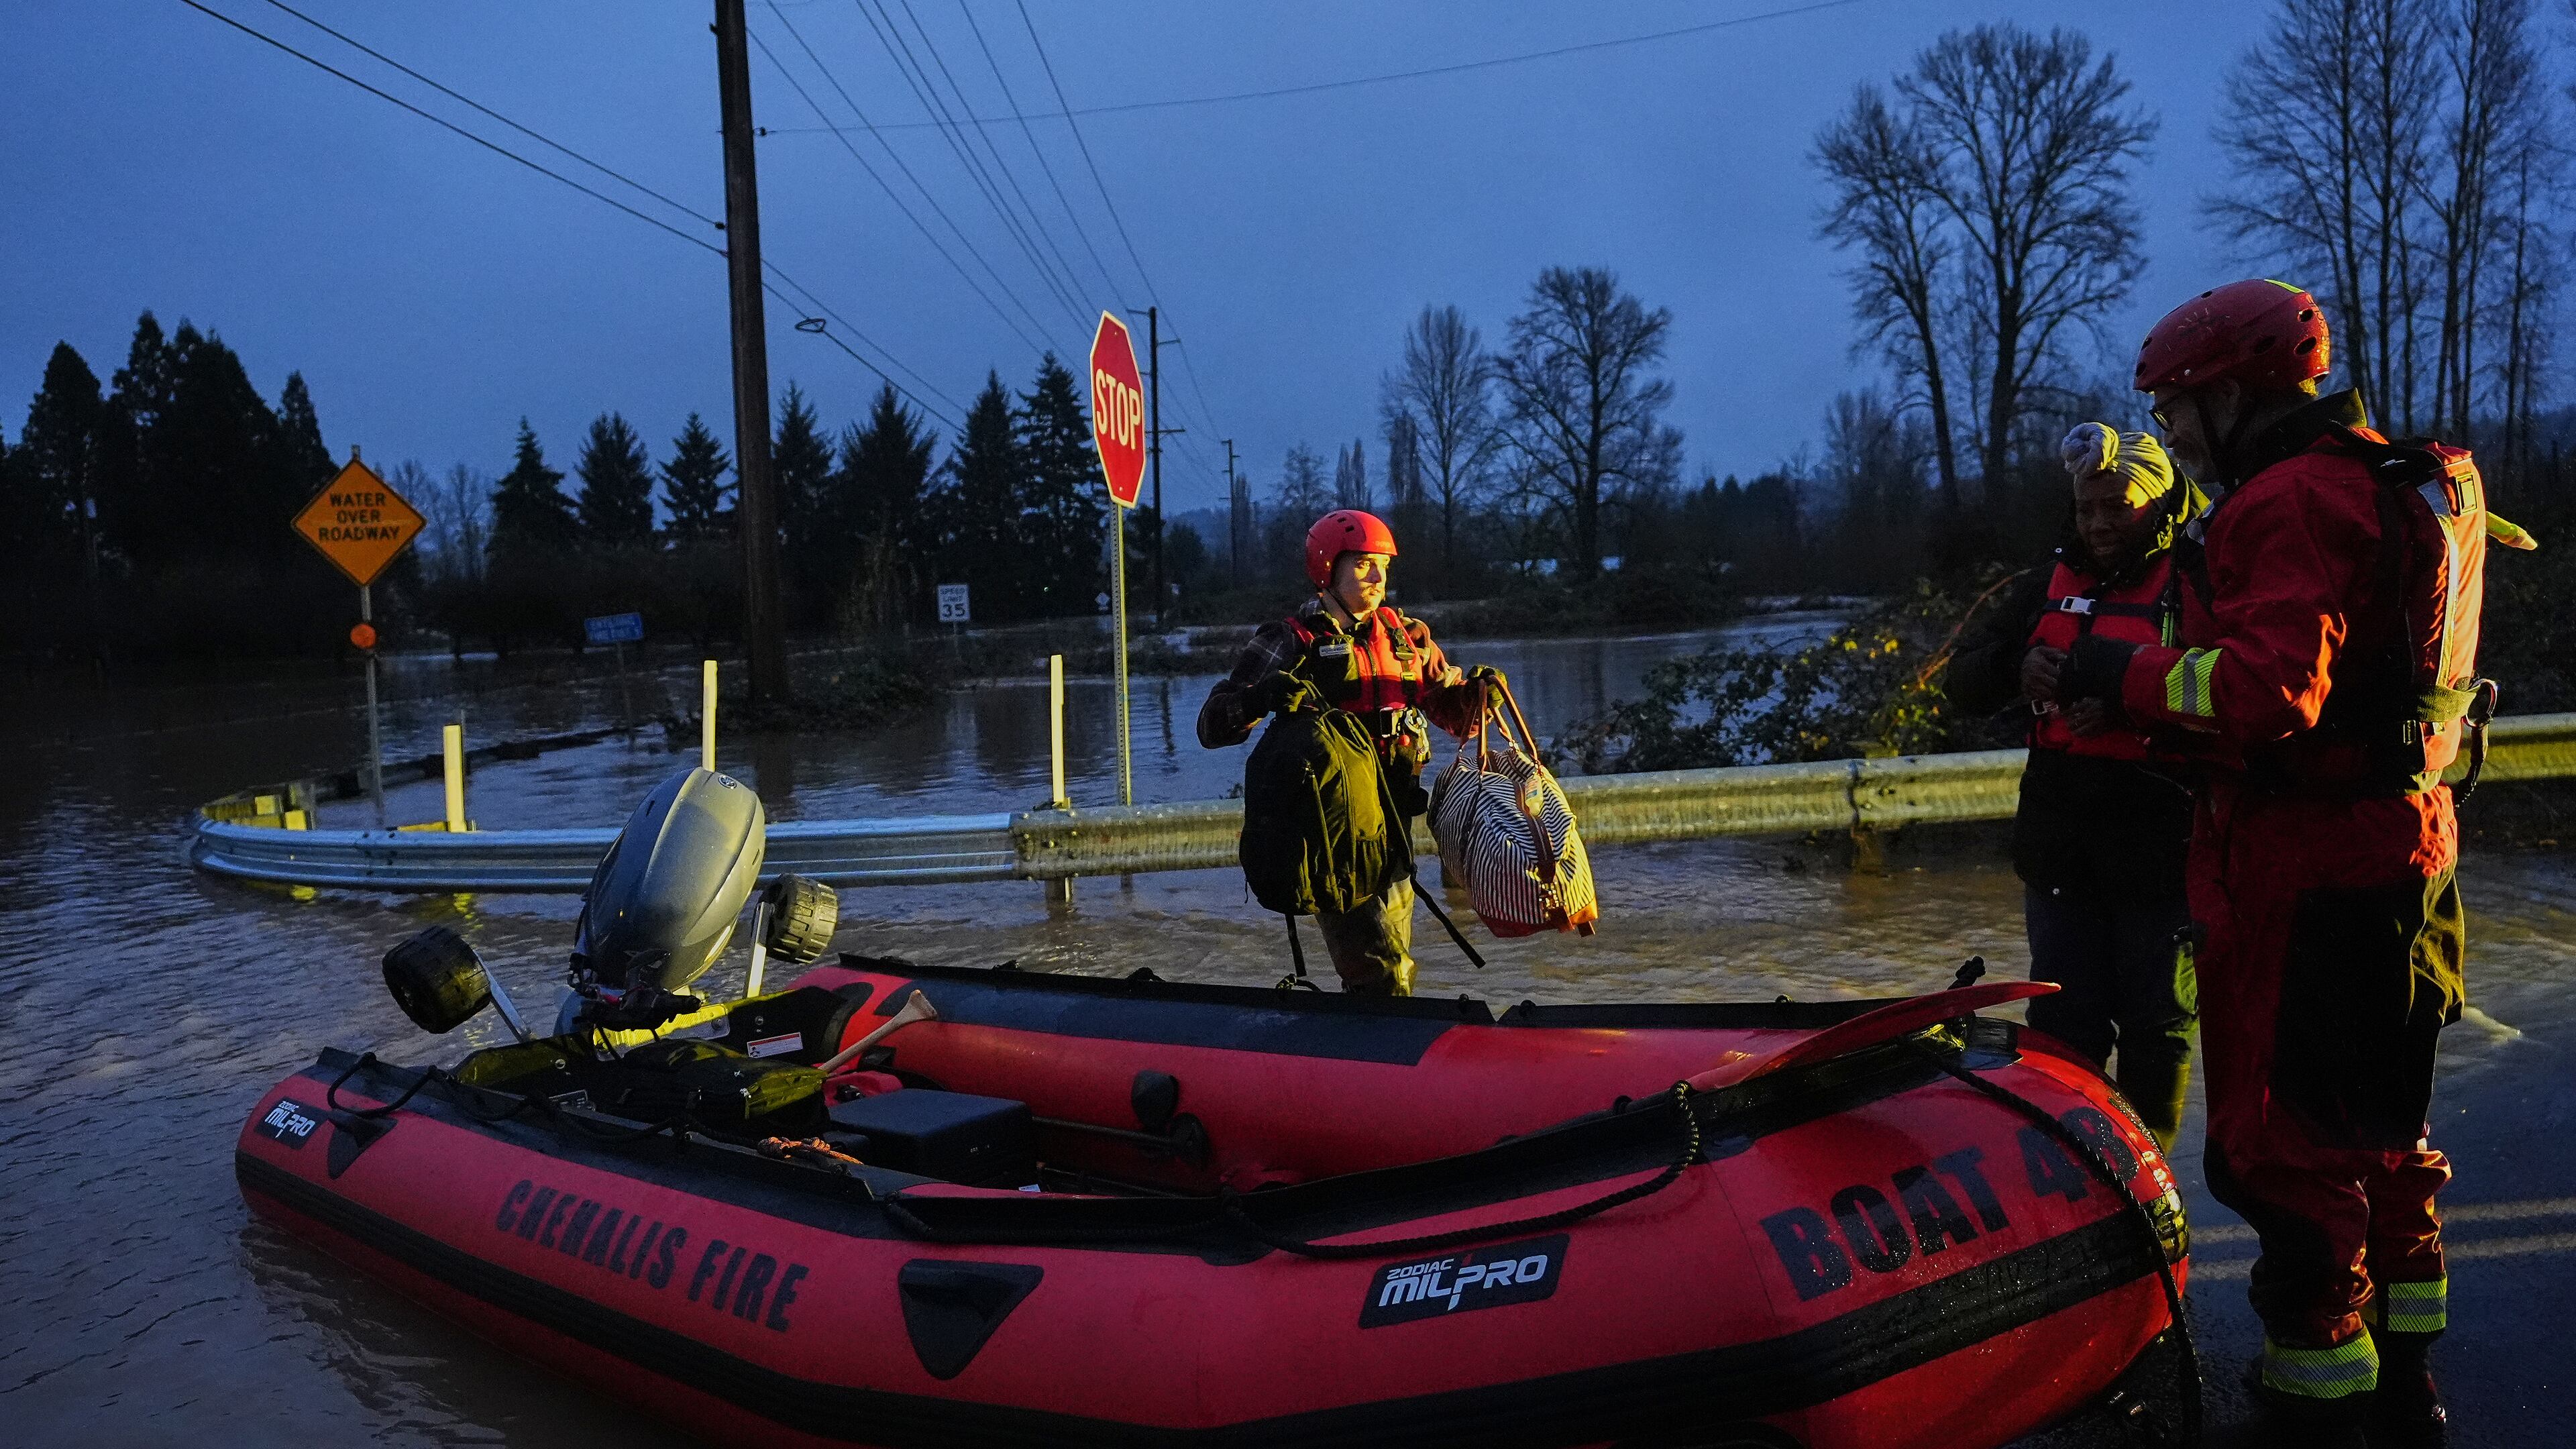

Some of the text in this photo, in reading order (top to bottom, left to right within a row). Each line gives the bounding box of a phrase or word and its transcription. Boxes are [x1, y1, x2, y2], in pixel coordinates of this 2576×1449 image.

[1095, 368, 1140, 450] STOP
[330, 492, 386, 507] WATER
[336, 509, 380, 524] OVER
[319, 526, 399, 541] ROADWAY
[942, 604, 965, 617] 35
[1760, 1107, 2140, 1302] BOAT 48
[496, 1179, 810, 1332] CHEHALIS FIRE
[1386, 1258, 1454, 1281] ZODIAC
